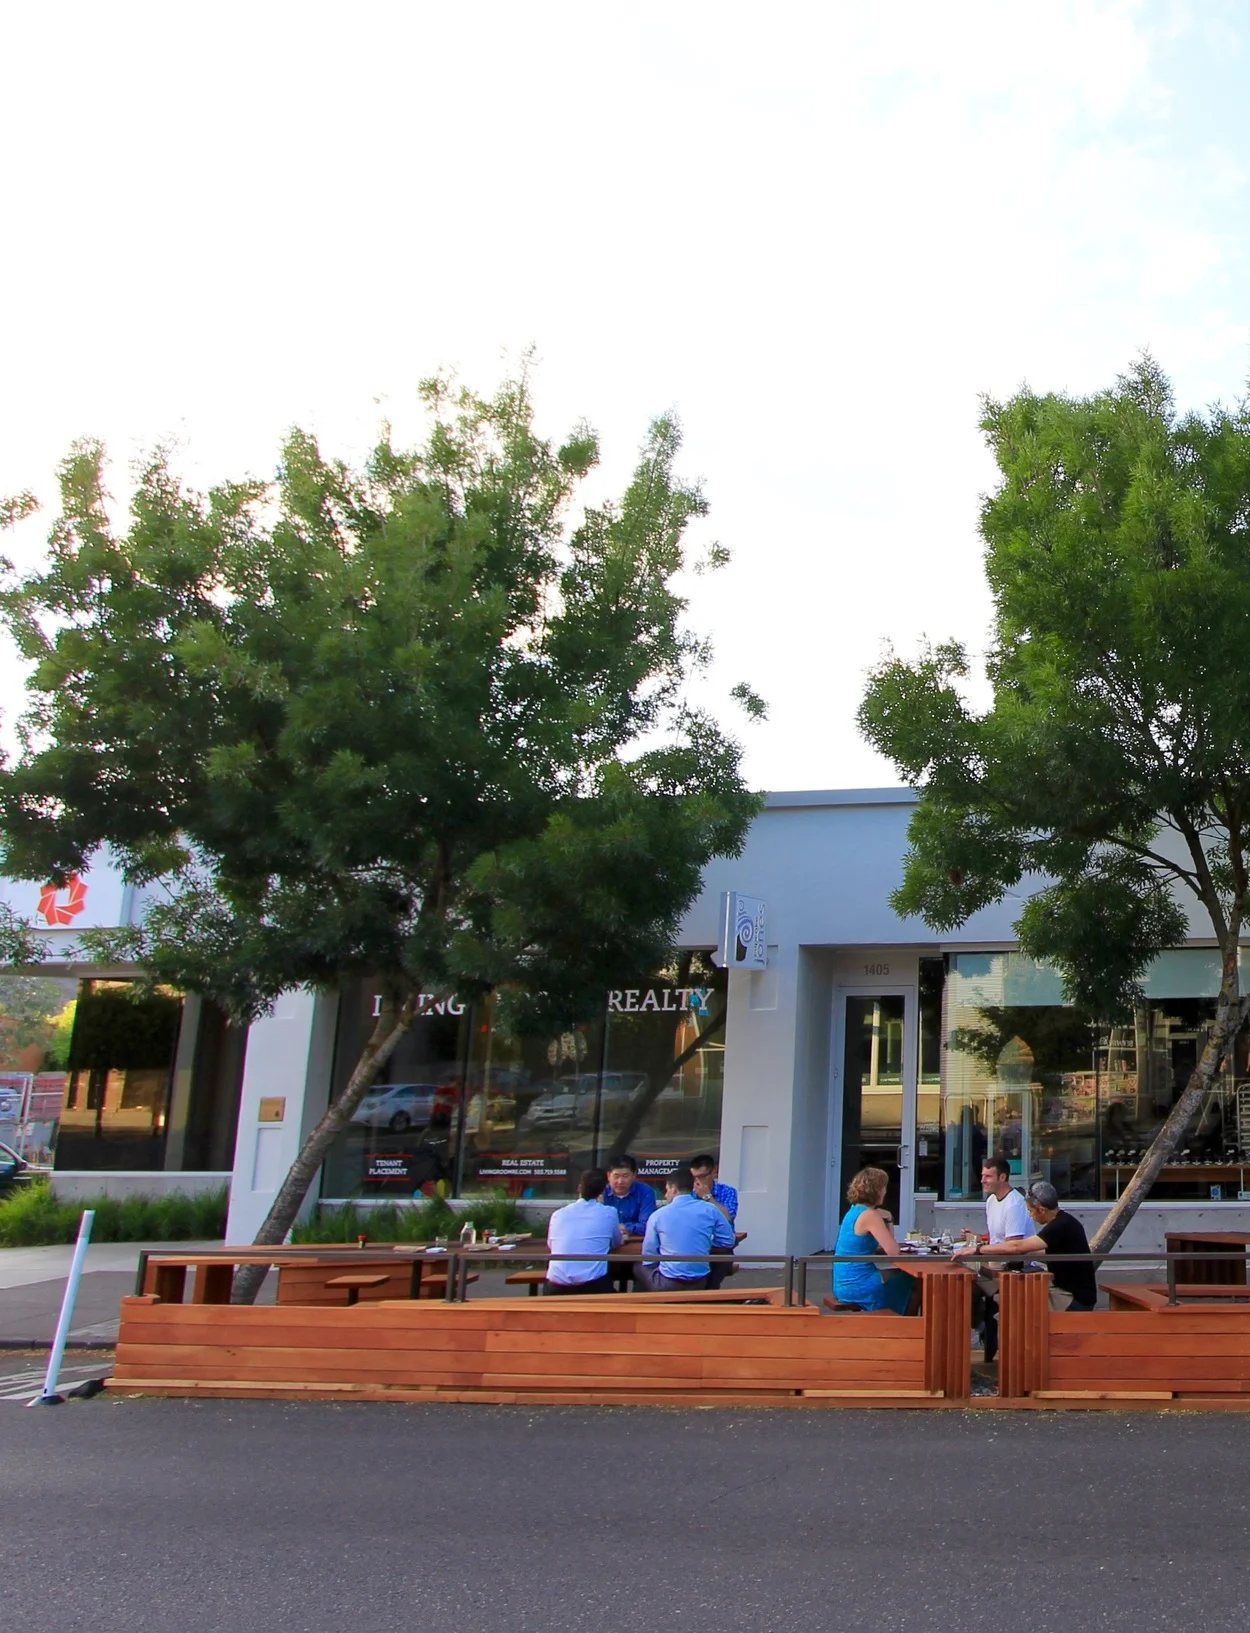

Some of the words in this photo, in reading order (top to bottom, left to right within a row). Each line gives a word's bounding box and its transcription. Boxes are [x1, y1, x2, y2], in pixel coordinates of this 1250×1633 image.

[754, 903, 766, 966] jones
[863, 963, 890, 976] 1405
[607, 987, 715, 1012] REALTY
[375, 1159, 403, 1167] TENANT
[501, 1159, 519, 1167] REAL
[520, 1159, 545, 1167] ESTATE
[645, 1159, 681, 1167] PROPERTY
[637, 1167, 680, 1175] MANAGEM
